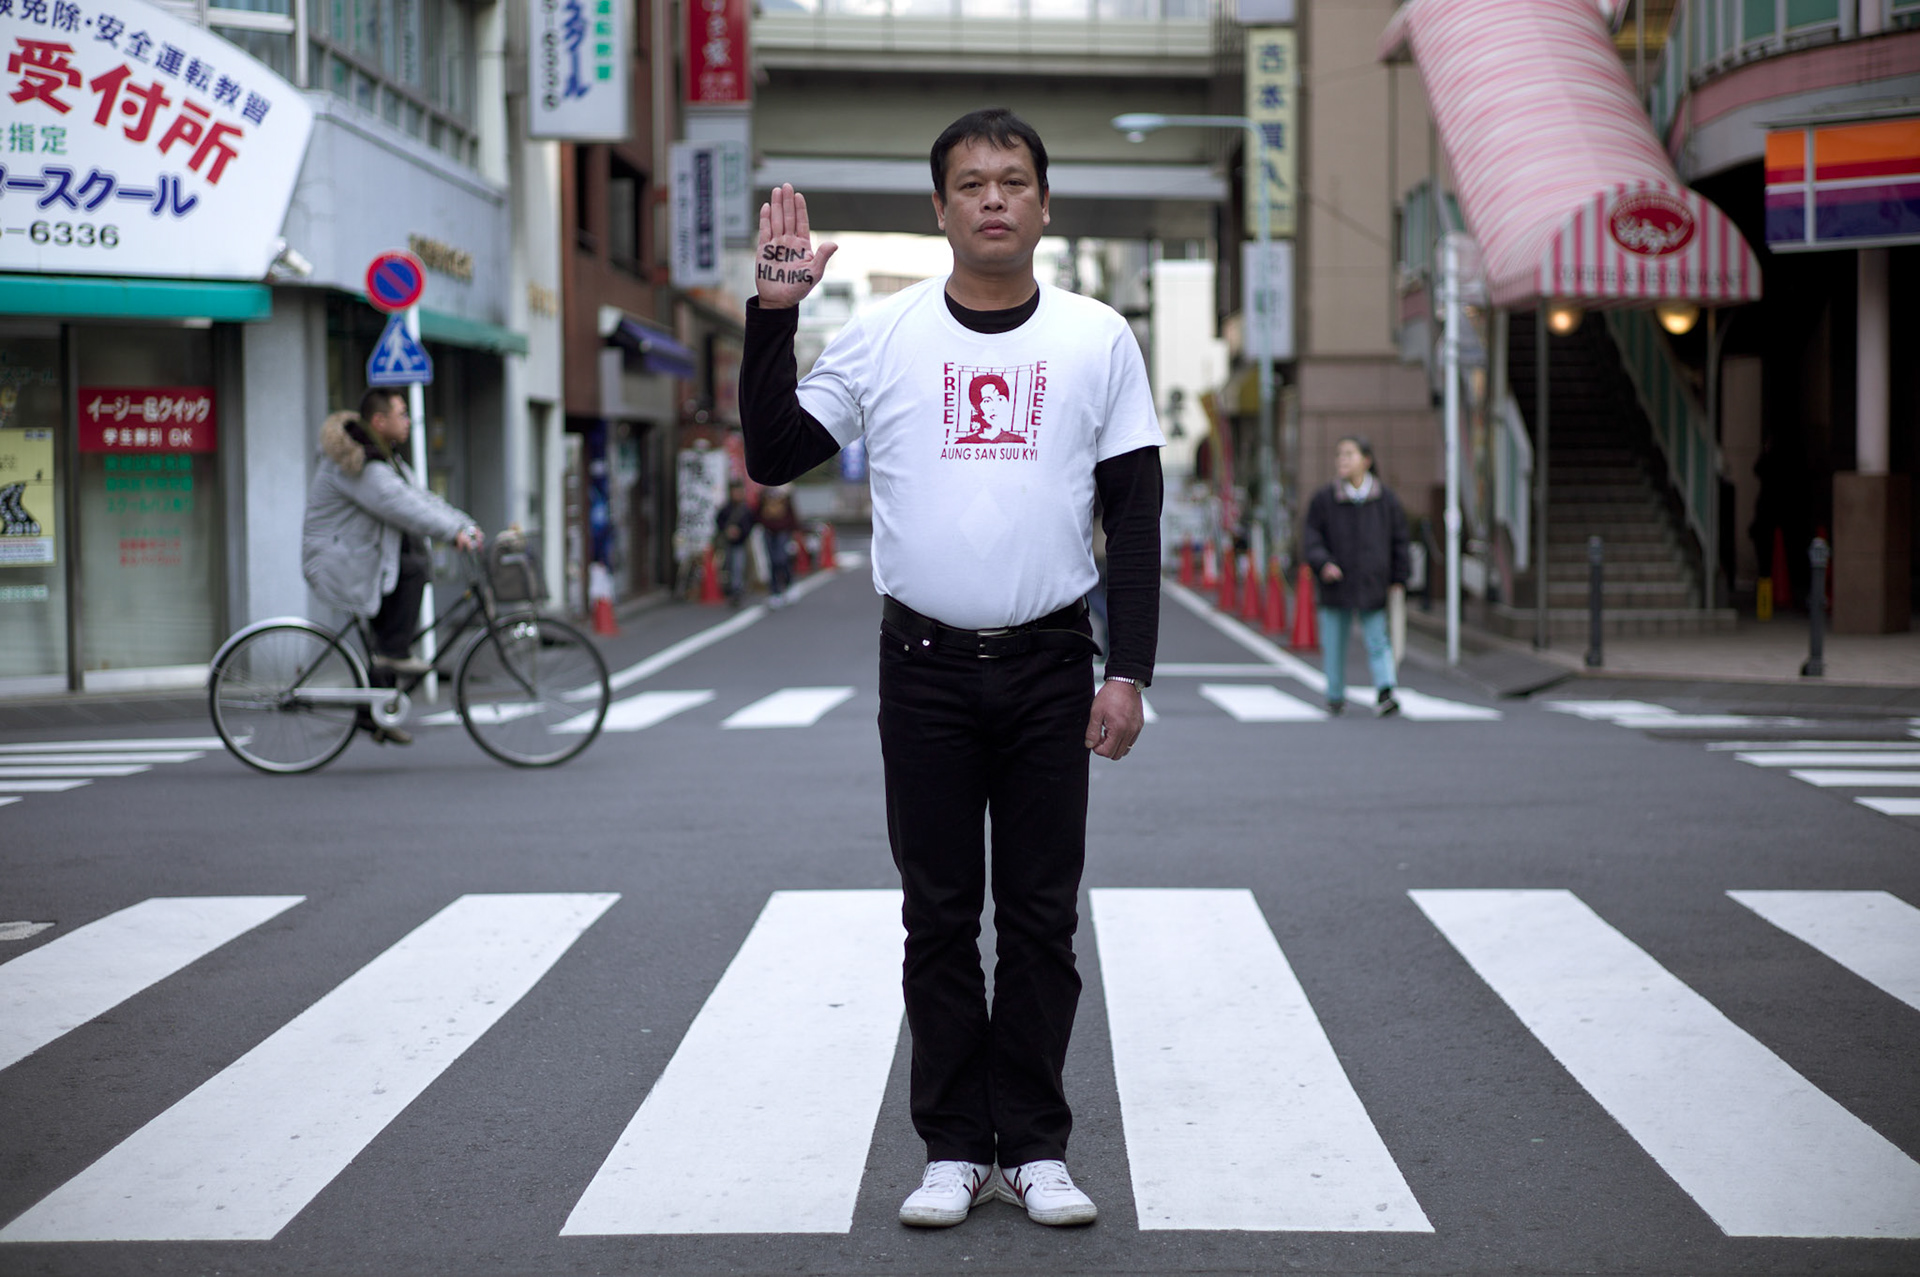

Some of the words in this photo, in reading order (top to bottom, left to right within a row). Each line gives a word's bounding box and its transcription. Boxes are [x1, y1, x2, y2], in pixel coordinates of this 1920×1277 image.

[7, 37, 245, 185] 受付所
[0, 122, 68, 155] 指定
[0, 166, 198, 217] ースクール
[0, 220, 119, 249] -6336
[762, 244, 806, 263] SEIN
[758, 263, 814, 285] HLAING
[168, 427, 193, 447] OK
[940, 448, 971, 460] AUNG
[975, 448, 997, 460] SAN
[1000, 448, 1019, 460] SUU
[1022, 448, 1038, 461] KYI
